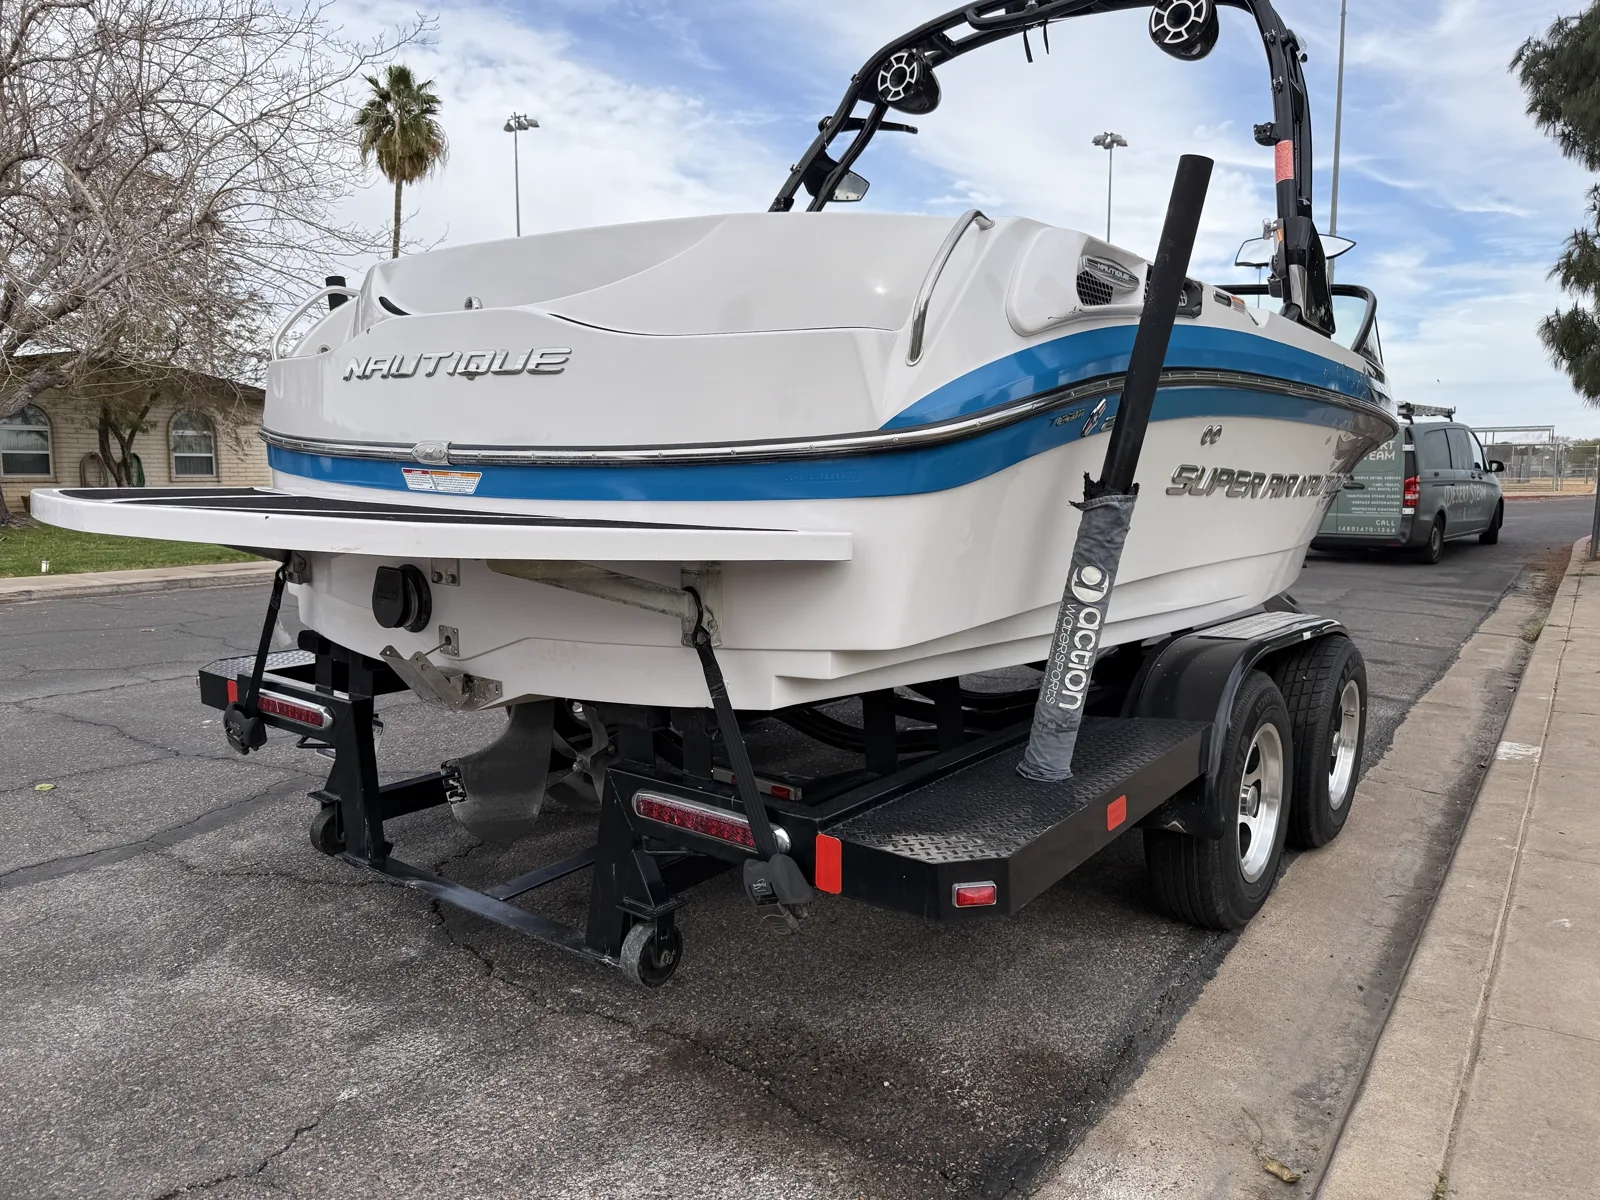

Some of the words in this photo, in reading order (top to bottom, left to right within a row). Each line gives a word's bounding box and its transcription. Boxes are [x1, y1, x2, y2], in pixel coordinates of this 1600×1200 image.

[342, 347, 572, 381] NAUTIQUE
[1165, 464, 1266, 499] SUPER
[1259, 473, 1301, 498] AIR
[1058, 606, 1101, 710] action
